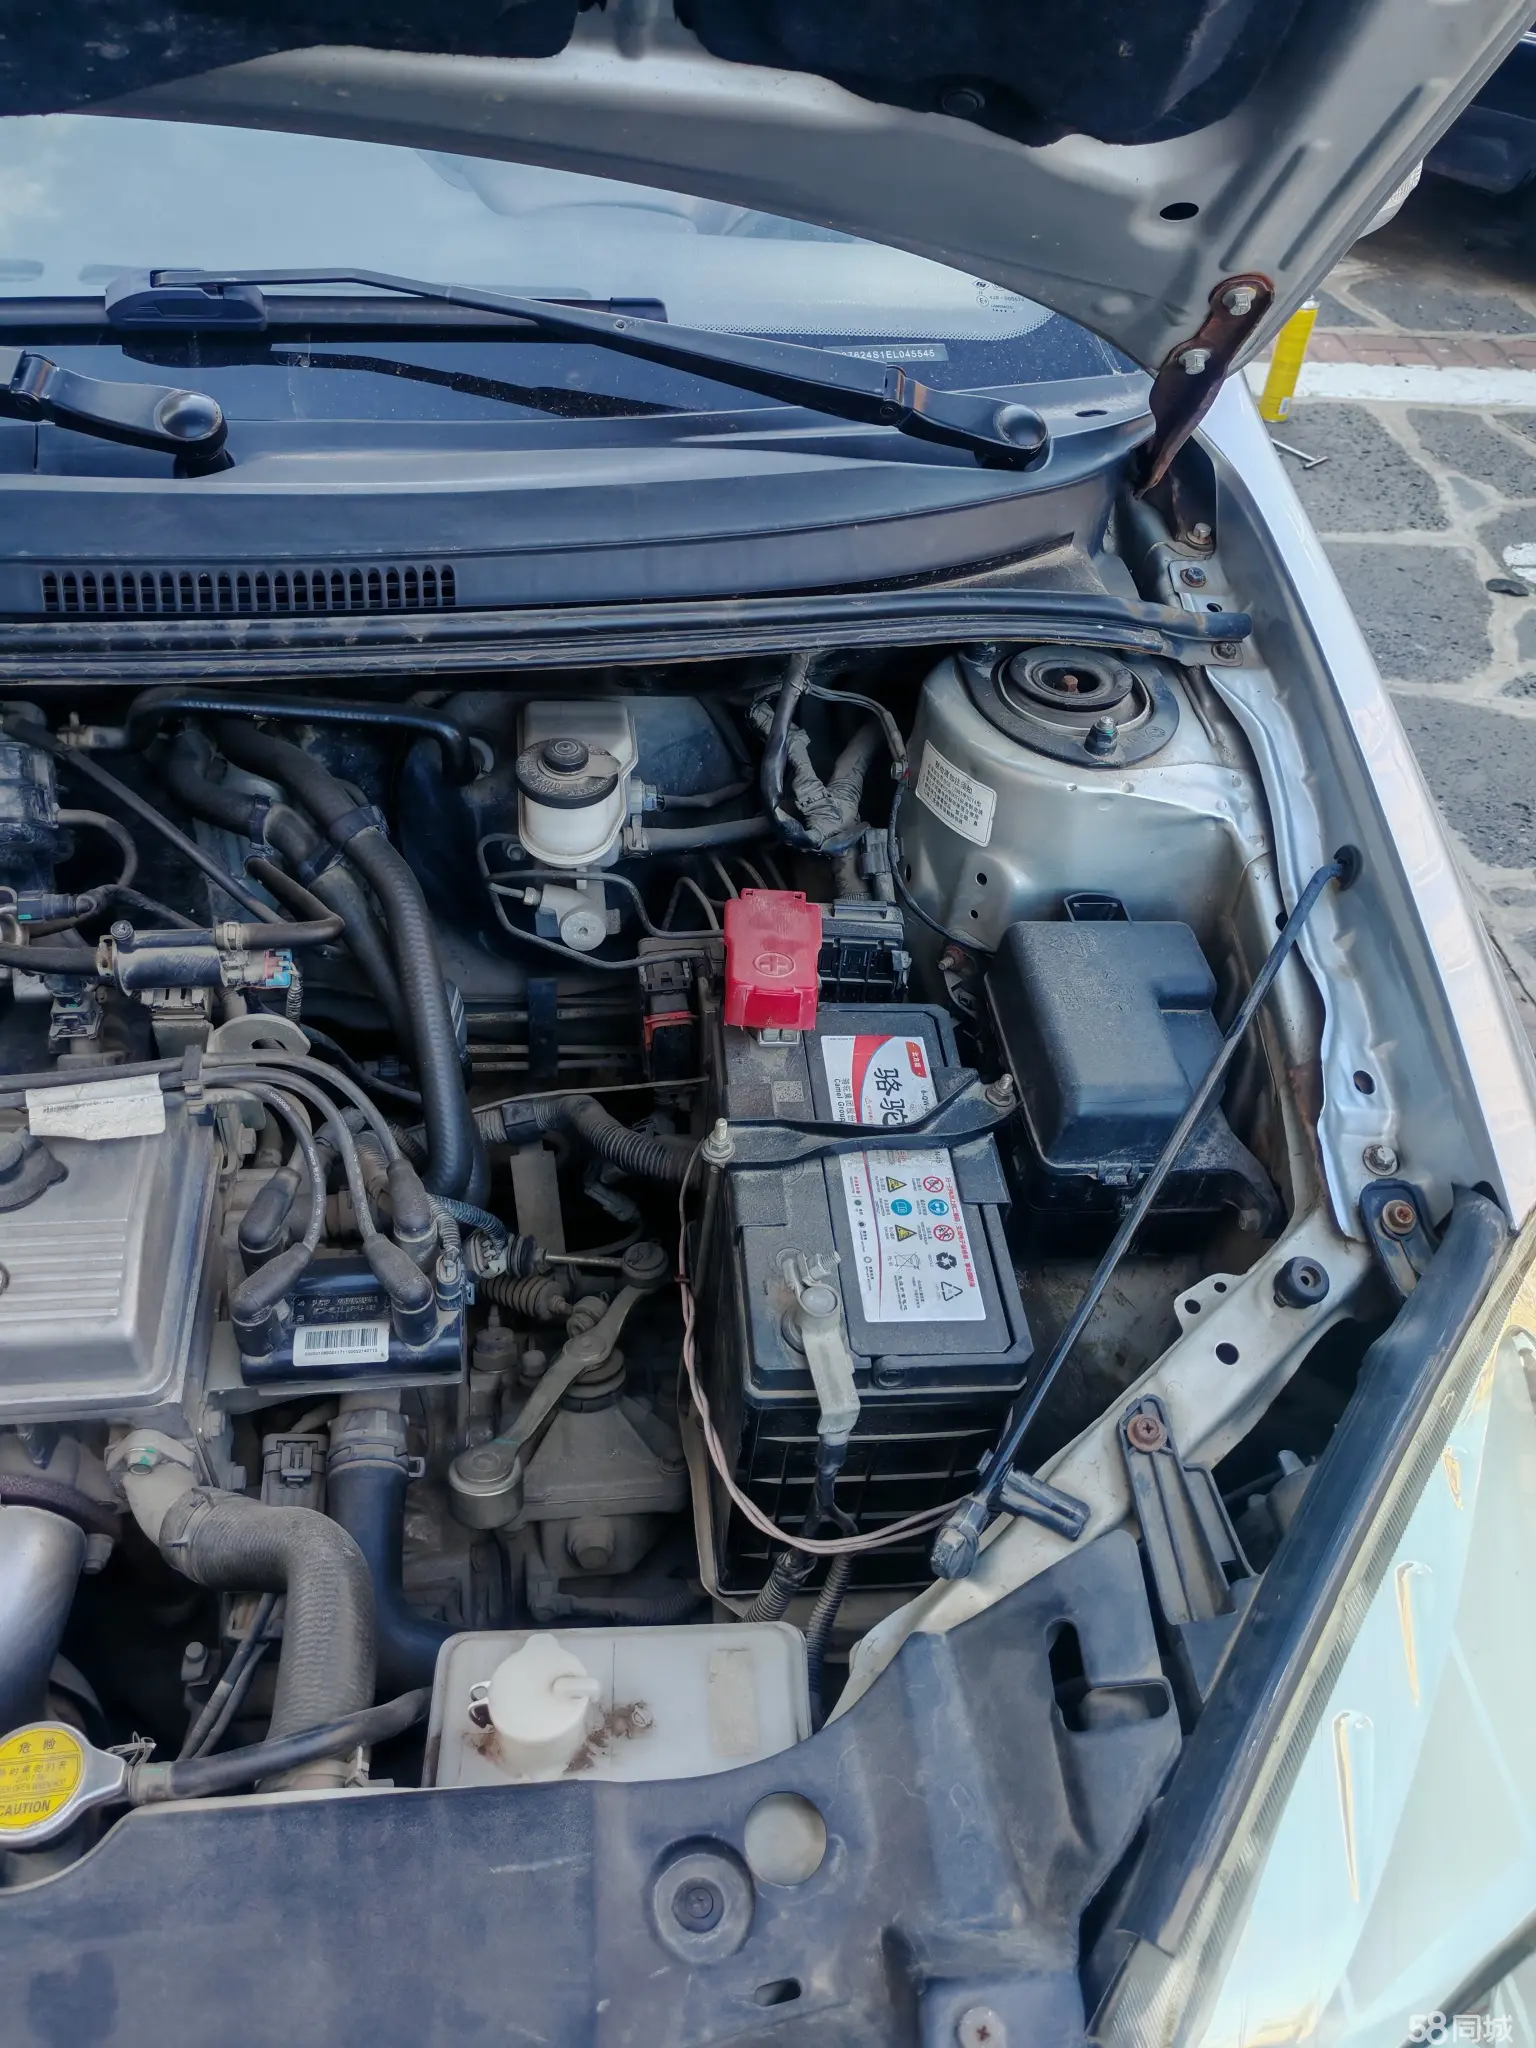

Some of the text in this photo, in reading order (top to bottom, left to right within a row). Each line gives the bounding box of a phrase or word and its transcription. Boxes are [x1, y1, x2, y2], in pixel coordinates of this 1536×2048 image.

[834, 1078, 846, 1122] Camel Group
[873, 1067, 908, 1126] 骆驼
[19, 1738, 56, 1754] 危险
